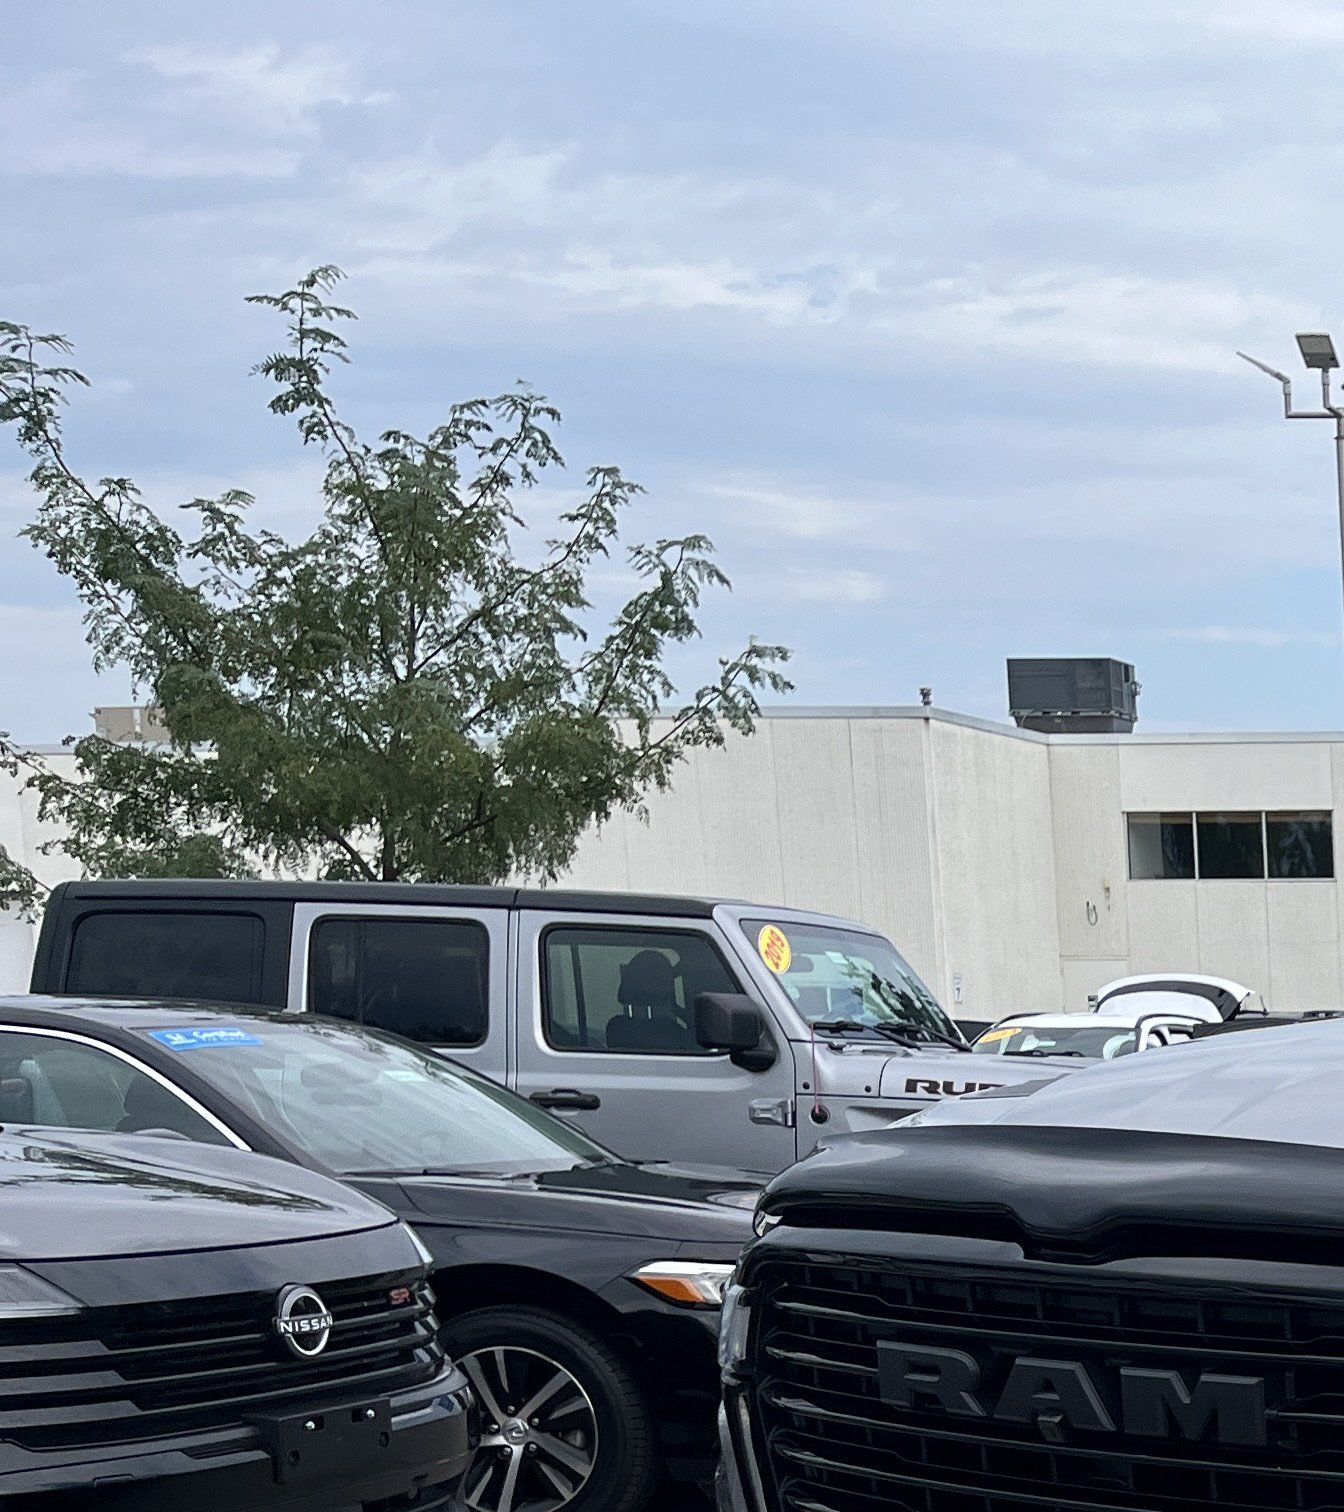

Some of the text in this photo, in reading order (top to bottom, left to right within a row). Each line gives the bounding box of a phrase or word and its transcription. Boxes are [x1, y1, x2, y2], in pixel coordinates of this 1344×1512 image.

[764, 929, 786, 971] 2019
[279, 1315, 333, 1333] NISSAN
[876, 1339, 1268, 1446] RAM
